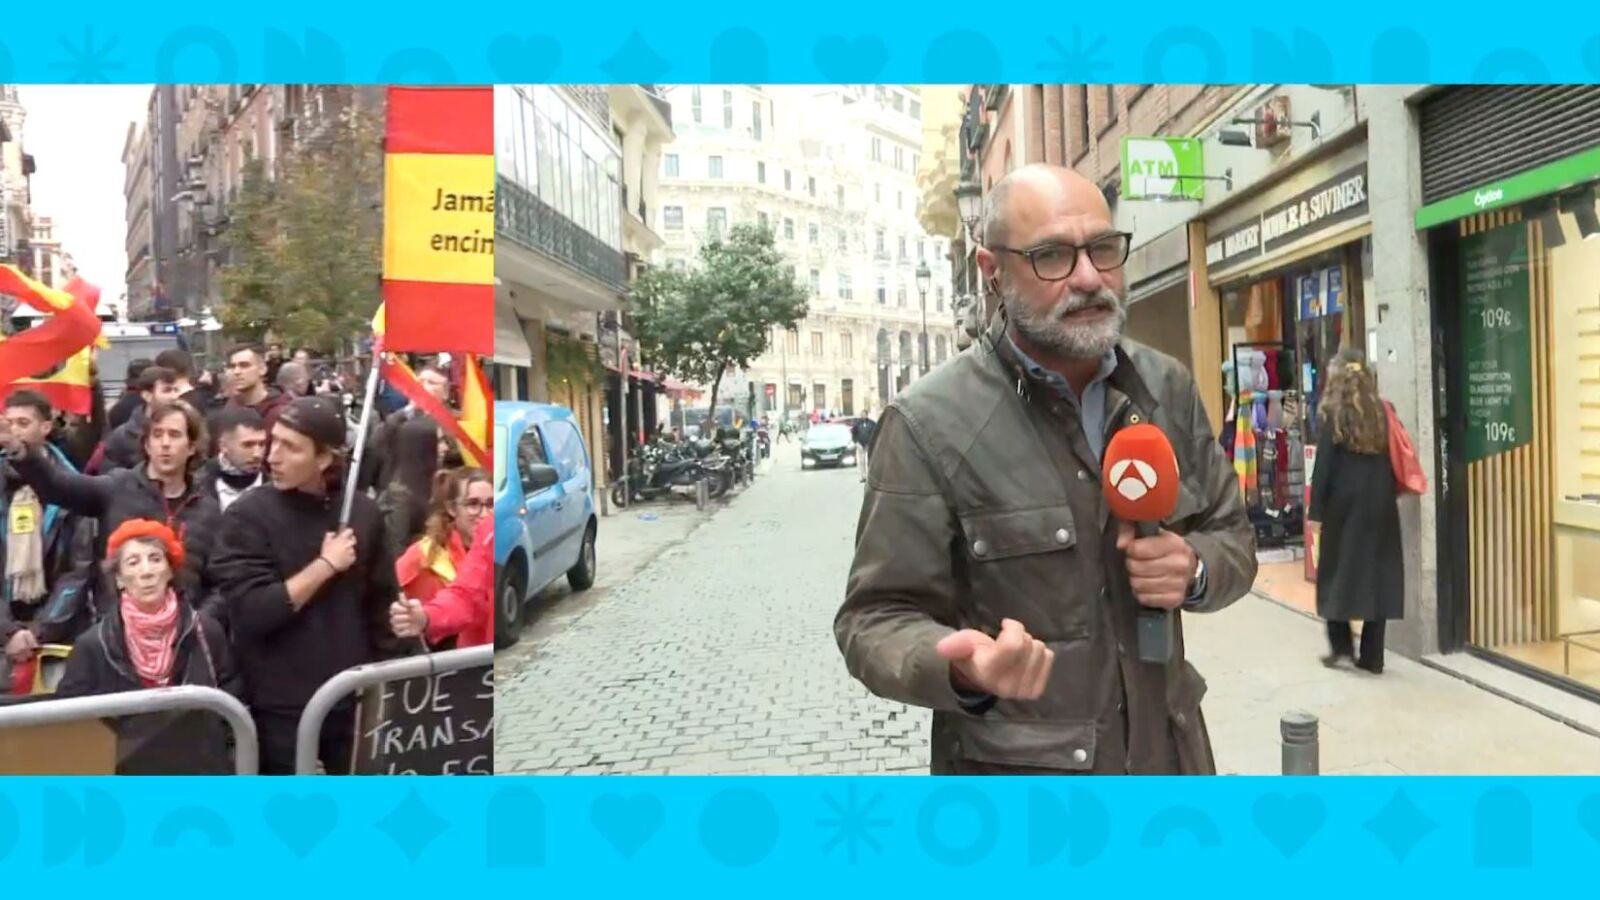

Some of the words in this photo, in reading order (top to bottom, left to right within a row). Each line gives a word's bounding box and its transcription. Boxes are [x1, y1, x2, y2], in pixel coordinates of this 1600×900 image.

[1130, 159, 1174, 176] ATM
[1310, 175, 1367, 221] SUVINER
[1480, 307, 1511, 328] 109€
[1485, 422, 1516, 442] 109€
[377, 670, 458, 720] FUE
